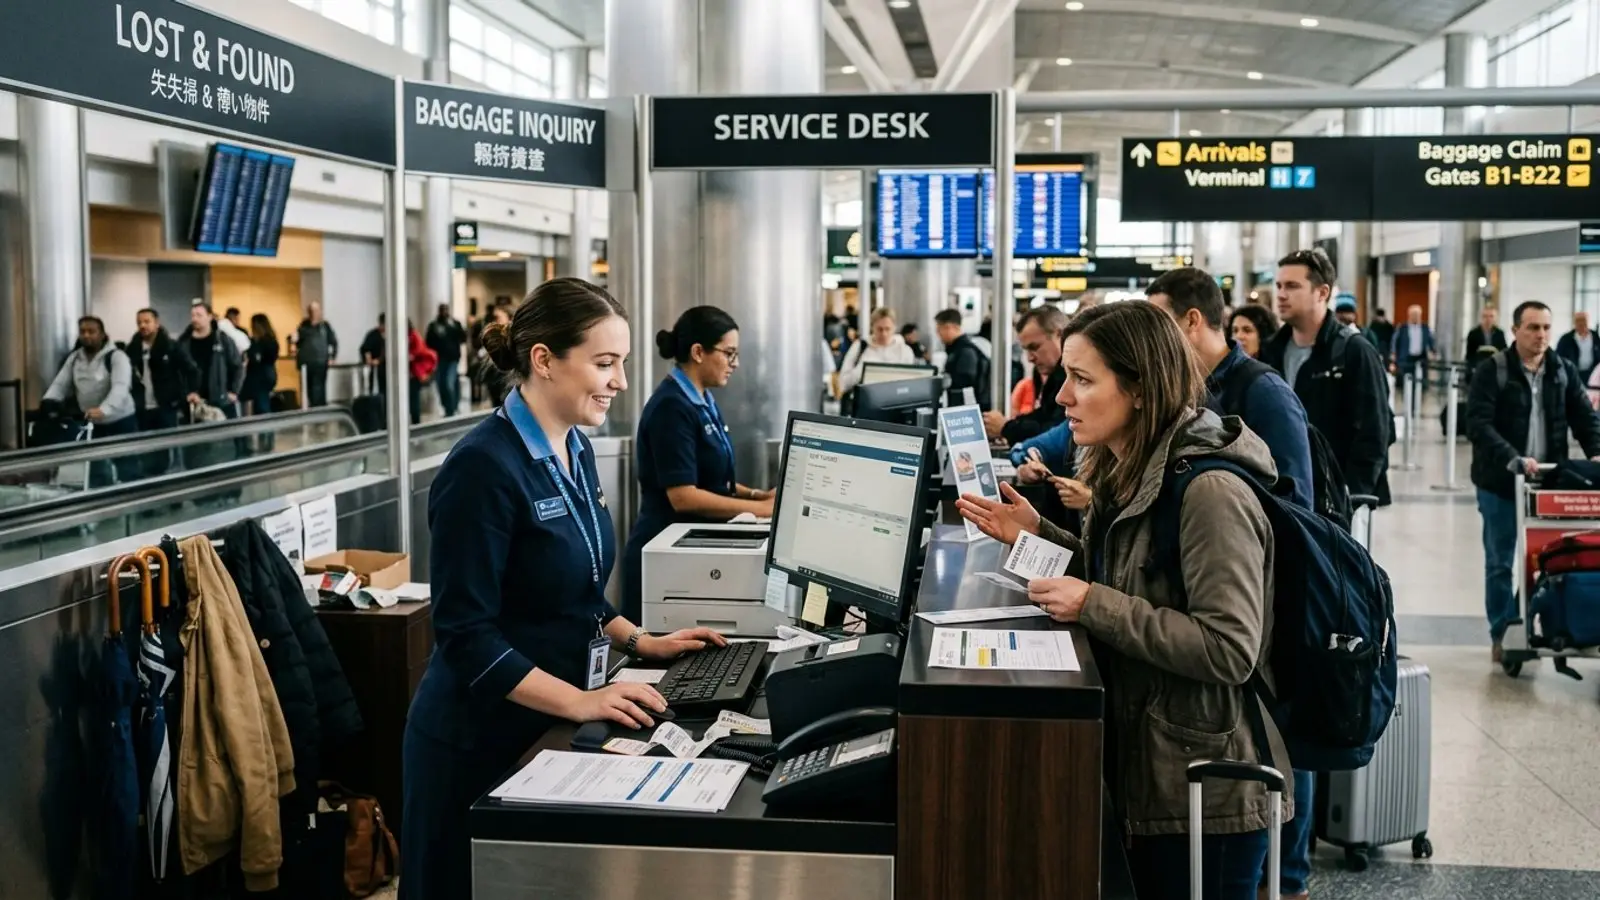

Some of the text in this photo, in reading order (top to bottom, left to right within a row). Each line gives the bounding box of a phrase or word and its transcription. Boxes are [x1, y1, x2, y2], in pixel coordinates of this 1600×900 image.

[115, 4, 295, 94] LOST & FOUND
[202, 84, 213, 109] &
[415, 96, 596, 144] BAGGAGE INQUIRY
[714, 112, 930, 141] SERVICE DESK
[1184, 141, 1267, 163] Arrivals
[1418, 140, 1562, 164] Baggage Claim
[1184, 168, 1265, 187] Verminal
[1297, 168, 1313, 187] 7
[1425, 165, 1561, 186] Gates B1-B22
